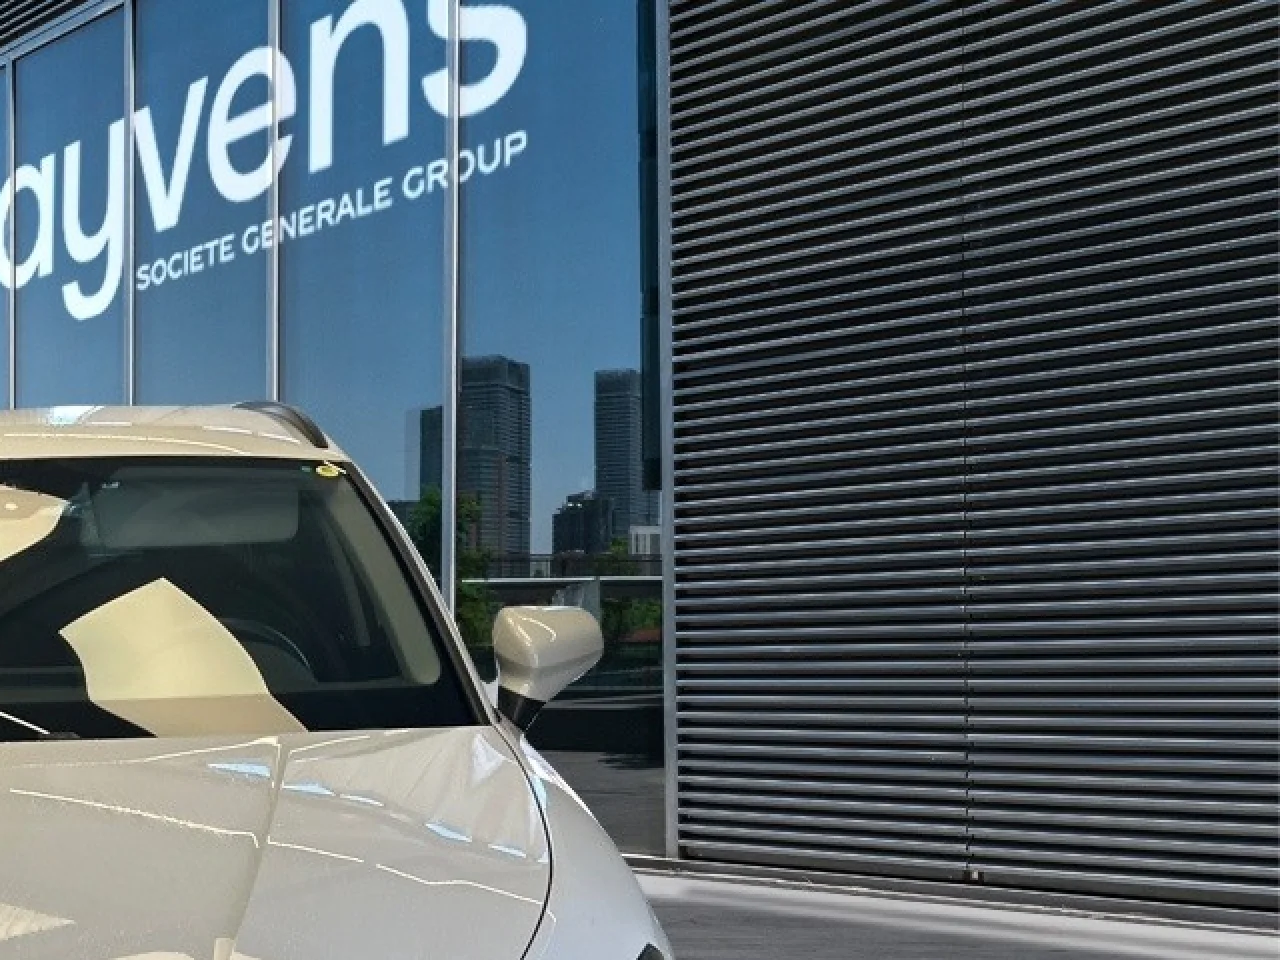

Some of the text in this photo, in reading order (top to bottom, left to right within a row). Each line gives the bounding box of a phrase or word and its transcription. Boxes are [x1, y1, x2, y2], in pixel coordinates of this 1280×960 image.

[135, 131, 527, 291] SOCIETE GENERALE GROUP
